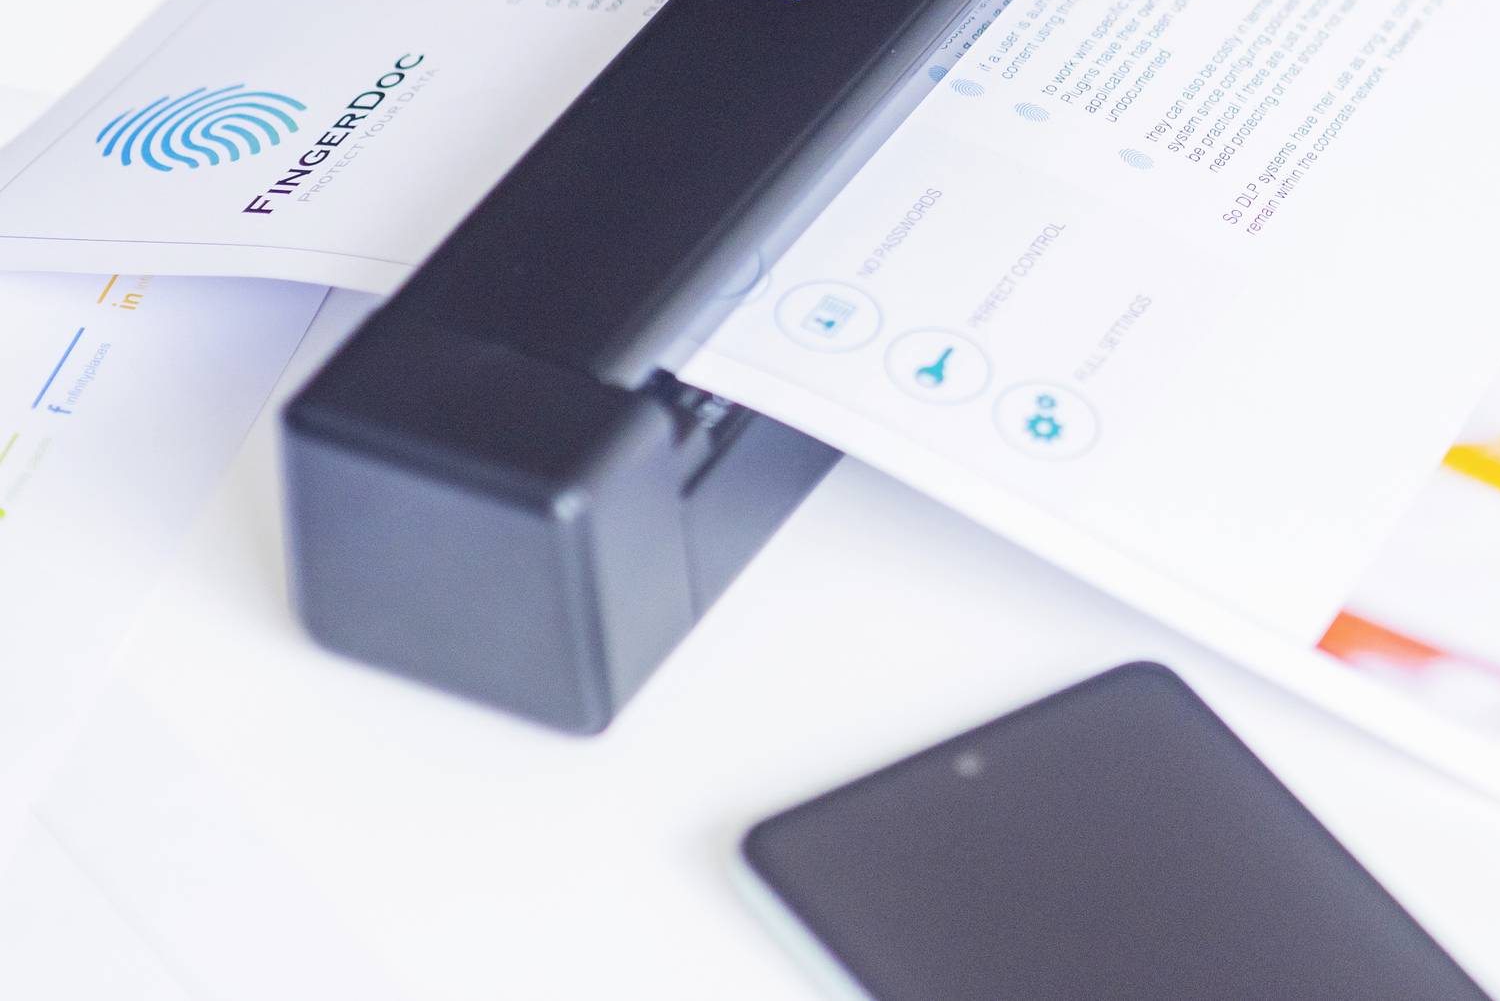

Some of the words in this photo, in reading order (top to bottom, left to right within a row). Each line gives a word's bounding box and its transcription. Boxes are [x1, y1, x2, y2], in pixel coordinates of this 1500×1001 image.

[996, 30, 1021, 55] user
[1000, 42, 1039, 80] content
[1033, 14, 1067, 43] using
[1051, 58, 1080, 86] work
[1073, 38, 1097, 60] with
[1090, 0, 1130, 40] specific
[1060, 67, 1101, 105] Plugins
[1091, 41, 1123, 68] have
[1114, 17, 1142, 42] their
[1084, 59, 1135, 114] application
[1127, 38, 1153, 60] has
[1144, 12, 1174, 40] been
[1143, 118, 1173, 143] they
[1165, 99, 1186, 120] can
[1181, 77, 1206, 101] also
[1211, 34, 1244, 65] costly
[1167, 116, 1203, 153] system
[1196, 88, 1225, 117] since
[1218, 33, 1273, 90] configuring
[297, 143, 366, 203] PROTECT
[358, 103, 405, 140] YOUR
[397, 67, 440, 104] DATA
[1201, 101, 1242, 149] practical
[1239, 67, 1271, 95] there
[1265, 49, 1286, 70] are
[1208, 143, 1236, 174] need
[1231, 95, 1280, 148] protecting
[1278, 61, 1304, 85] that
[1234, 181, 1260, 209] DLP
[1257, 141, 1297, 184] systems
[1288, 115, 1319, 142] have
[1311, 90, 1337, 115] their
[1332, 70, 1355, 92] use
[1245, 198, 1281, 236] remain
[1273, 169, 1305, 199] within
[1296, 151, 1318, 170] the
[1312, 101, 1357, 153] corporate
[875, 187, 943, 262] PASSWORDS
[1010, 221, 1067, 278] CONTROL
